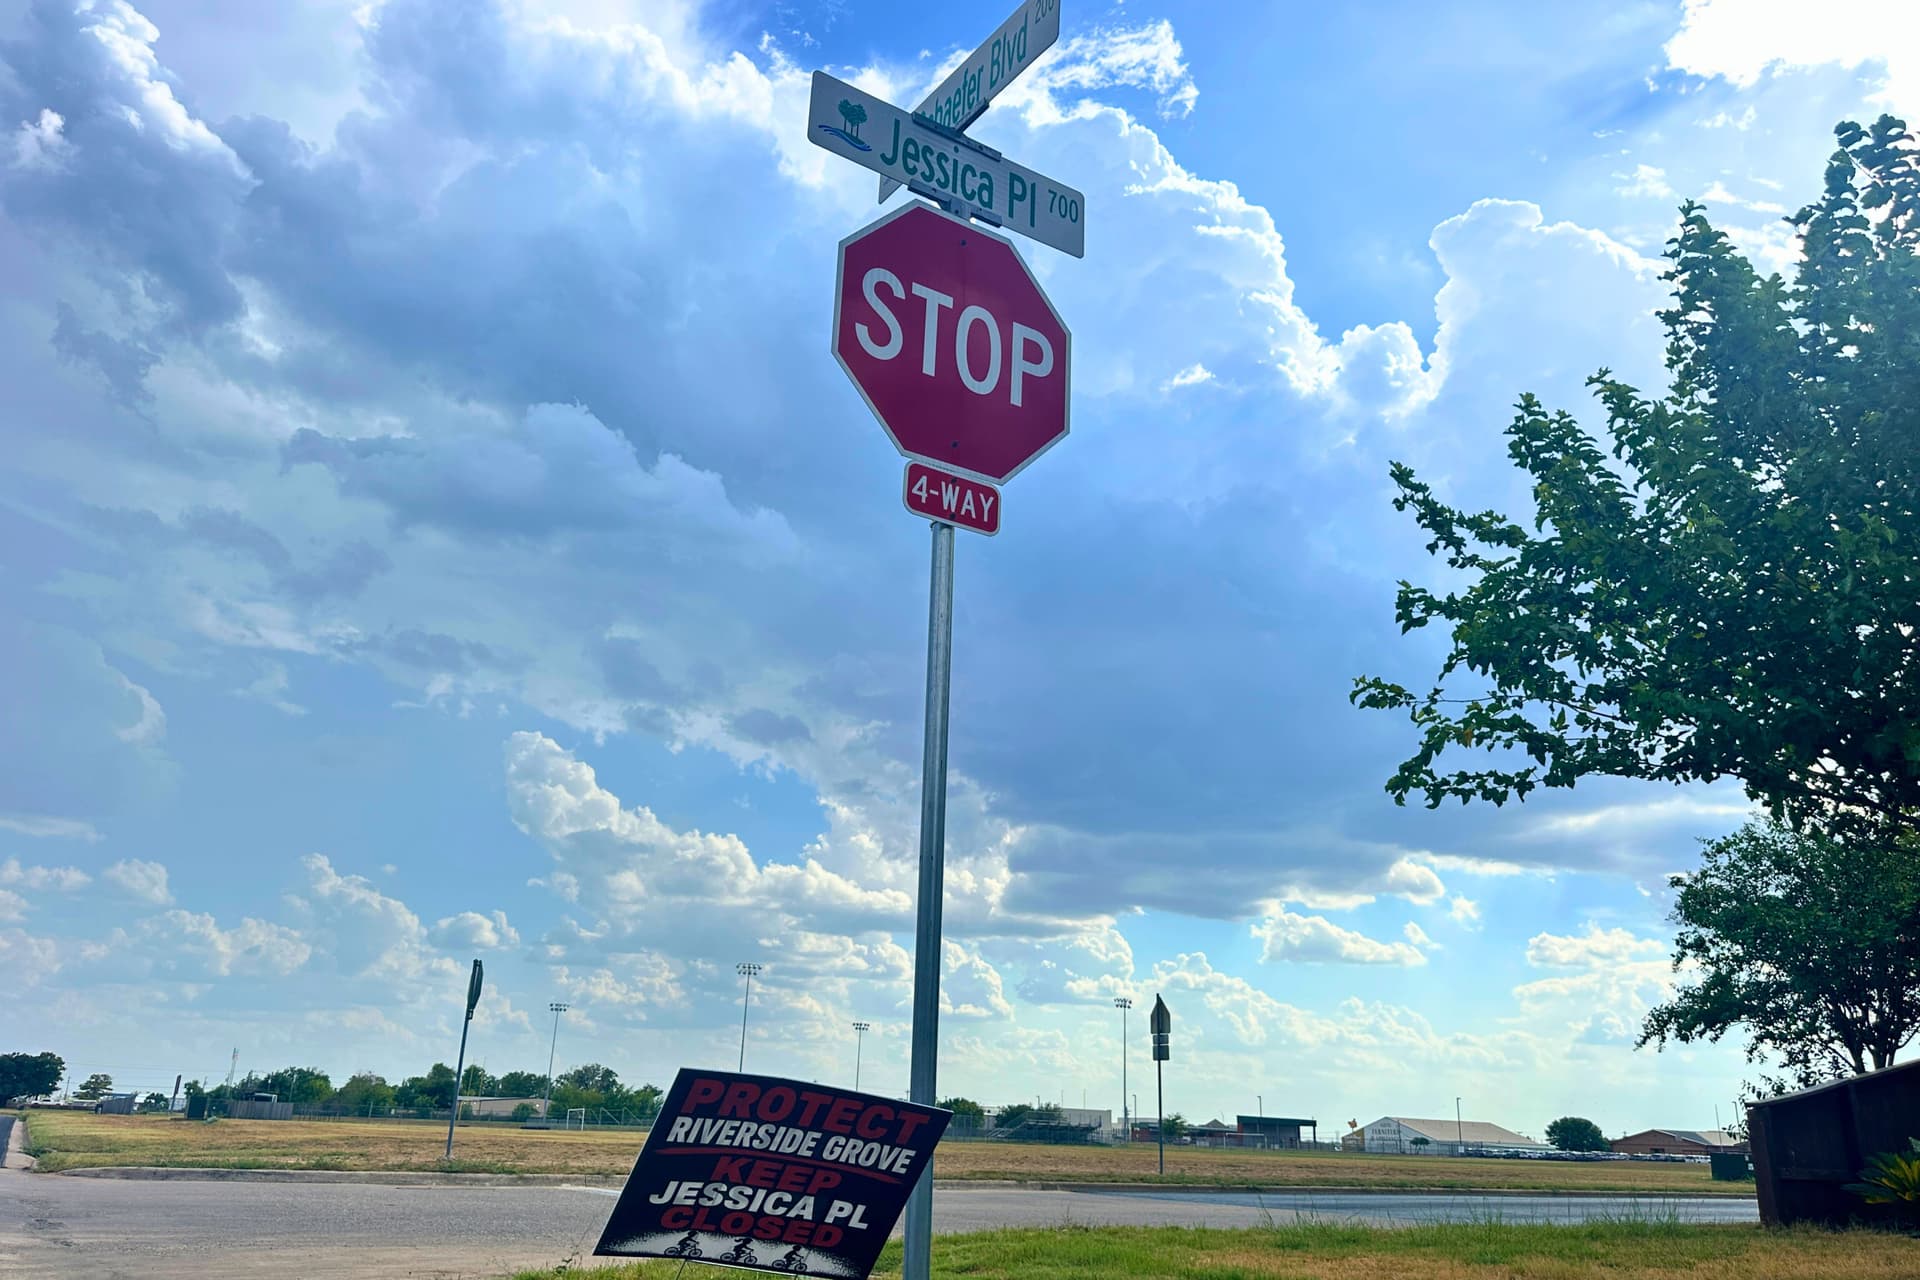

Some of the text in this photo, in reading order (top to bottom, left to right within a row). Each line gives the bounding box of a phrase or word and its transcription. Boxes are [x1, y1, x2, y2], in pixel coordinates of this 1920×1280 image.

[920, 64, 984, 128] haefer
[990, 10, 1028, 89] Blvd
[880, 118, 1079, 228] Jessica Pl 700
[855, 267, 1054, 408] STOP
[911, 475, 994, 523] 4-WAY
[680, 1078, 930, 1145] PROTECT
[666, 1116, 916, 1175] RIVERSIDE GROVE
[649, 1180, 869, 1230] JESSICA PL
[710, 1157, 843, 1195] KEEP
[660, 1207, 844, 1249] CLOSED
